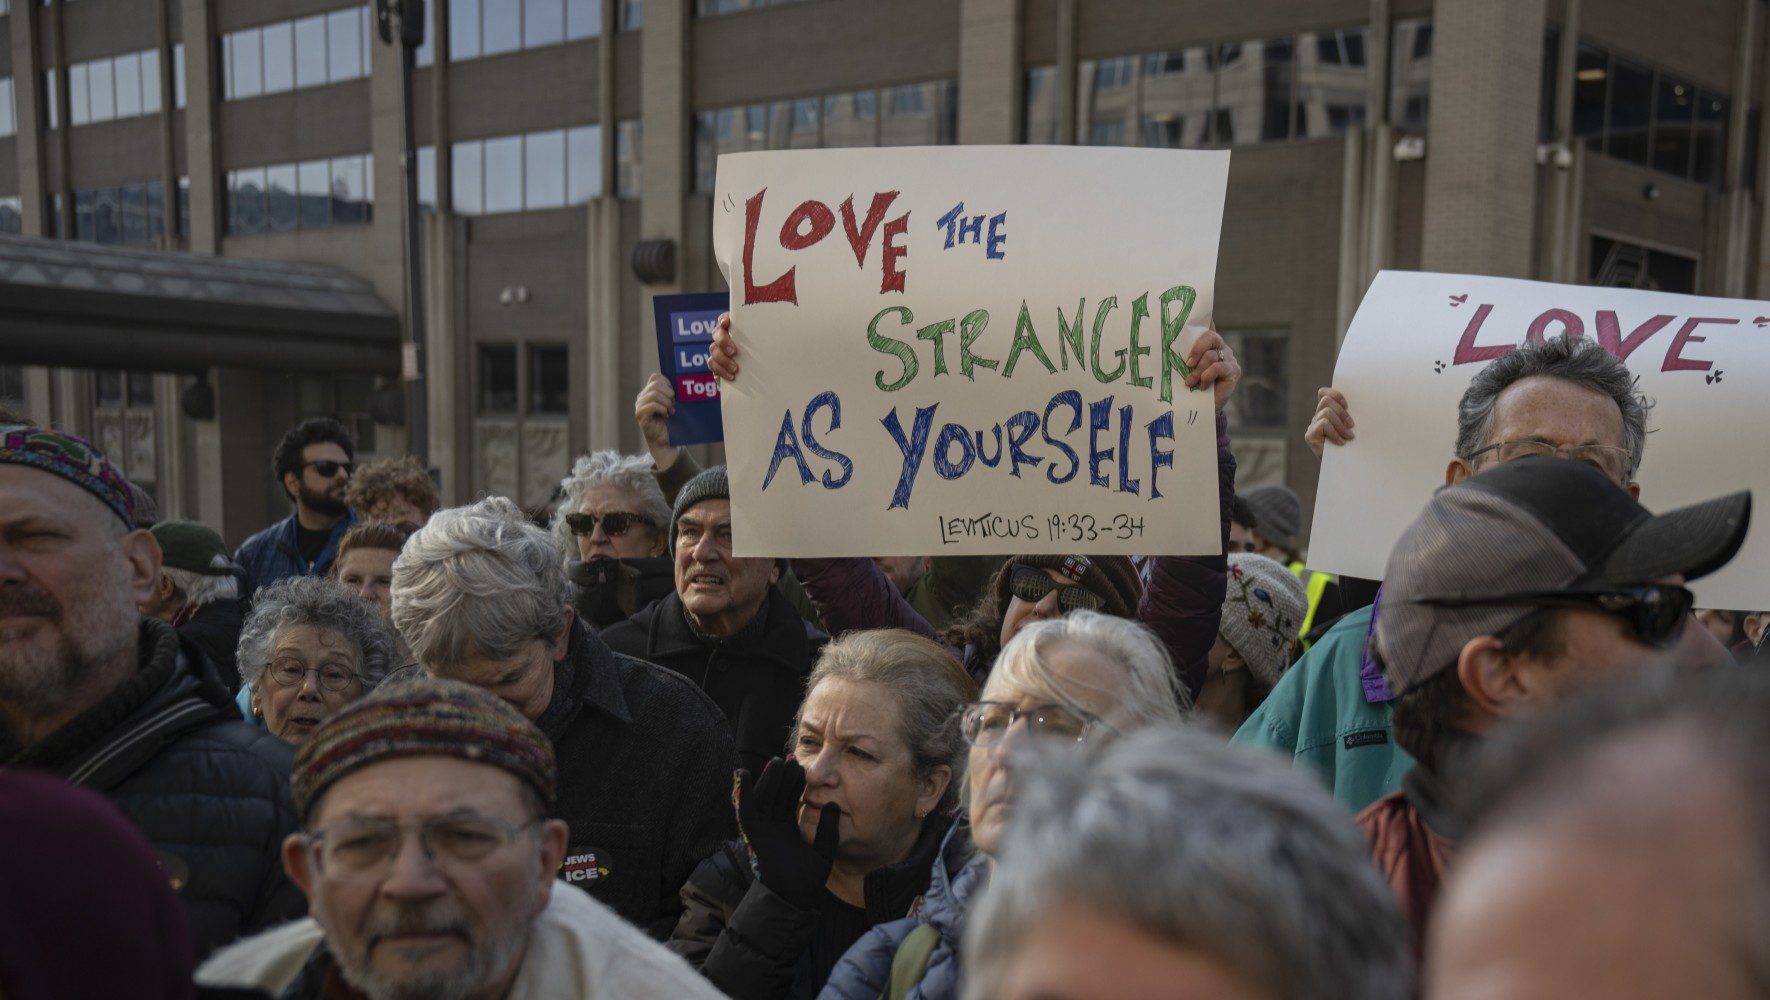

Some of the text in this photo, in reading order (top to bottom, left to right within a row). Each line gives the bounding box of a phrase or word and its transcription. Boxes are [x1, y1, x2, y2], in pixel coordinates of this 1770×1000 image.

[937, 201, 1008, 260] THE
[677, 317, 716, 336] Lov
[1452, 303, 1740, 372] LOVE
[867, 285, 1200, 402] STRANGER
[680, 349, 709, 368] Lo
[682, 379, 721, 398] Tog
[762, 391, 853, 492] AS
[938, 512, 1146, 544] LEVITICUS 19:33-34
[564, 853, 596, 866] JEWS
[565, 867, 599, 882] ICE
